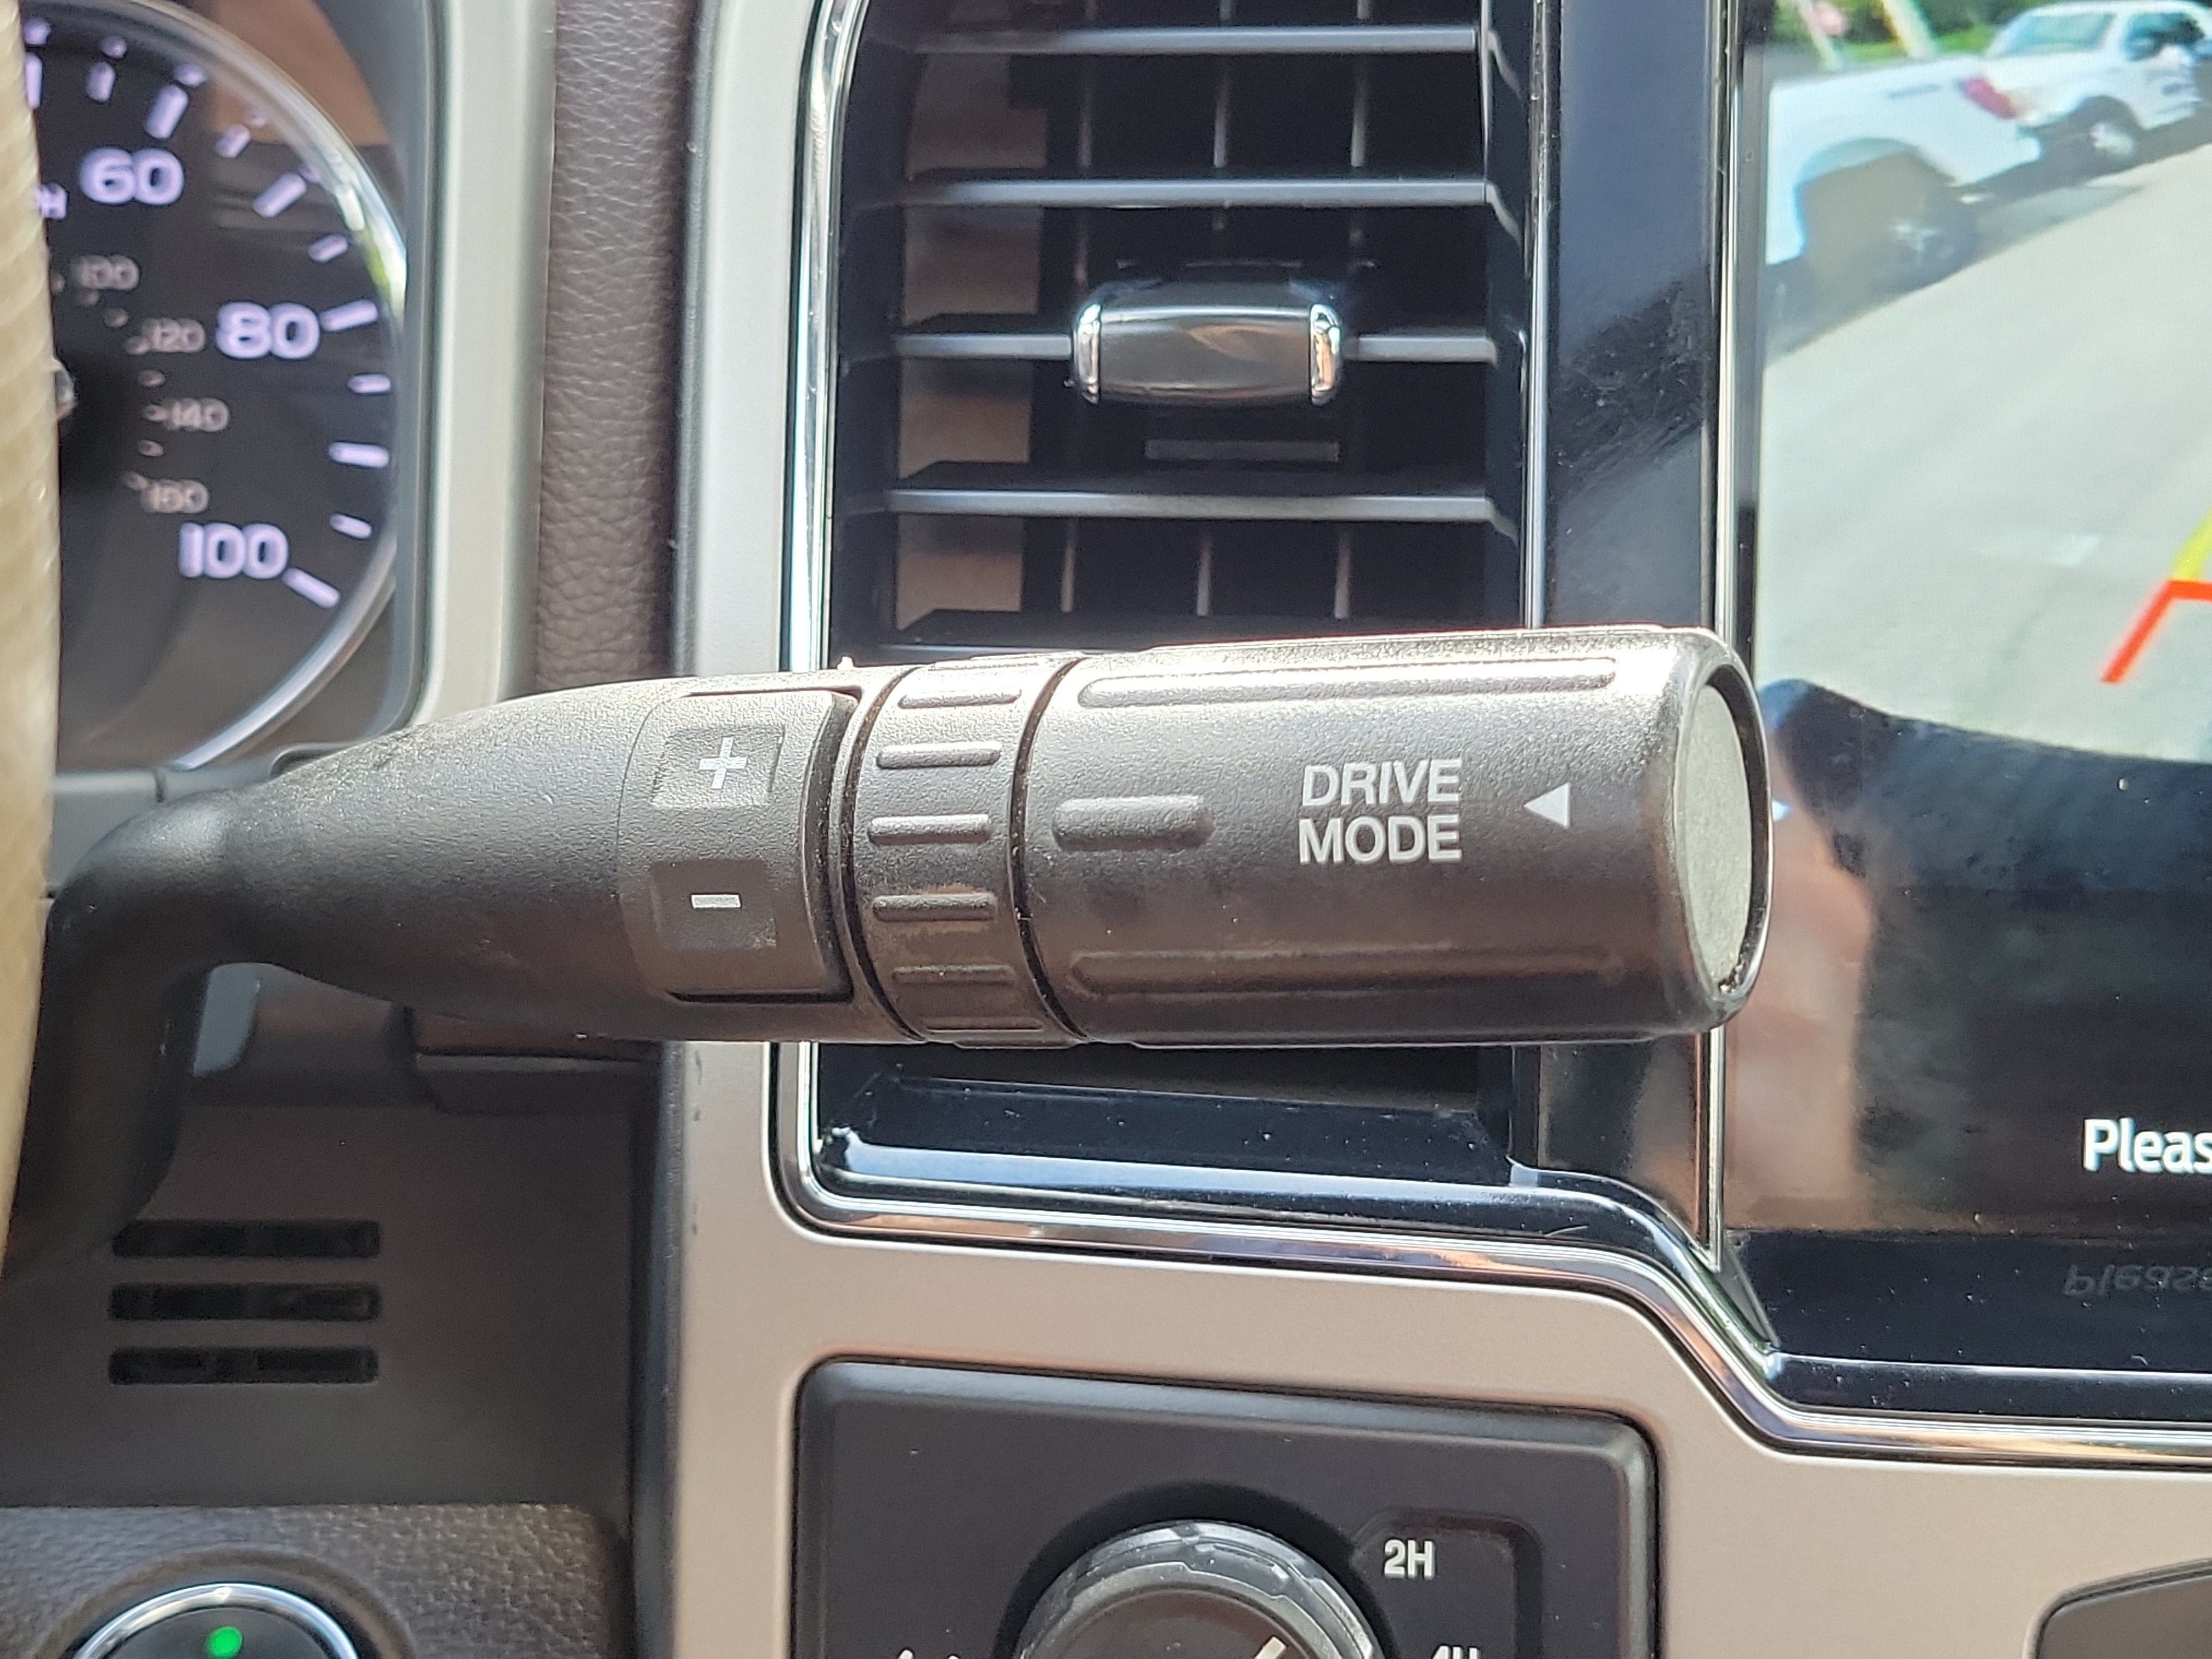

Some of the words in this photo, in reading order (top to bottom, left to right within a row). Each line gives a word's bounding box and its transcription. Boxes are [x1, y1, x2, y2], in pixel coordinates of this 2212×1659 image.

[80, 146, 185, 205] 60
[216, 301, 320, 359] 80
[178, 522, 289, 579] 100
[1302, 759, 1463, 806] DRIVE
[1299, 814, 1463, 865] MODE
[1384, 1539, 1435, 1580] 2H
